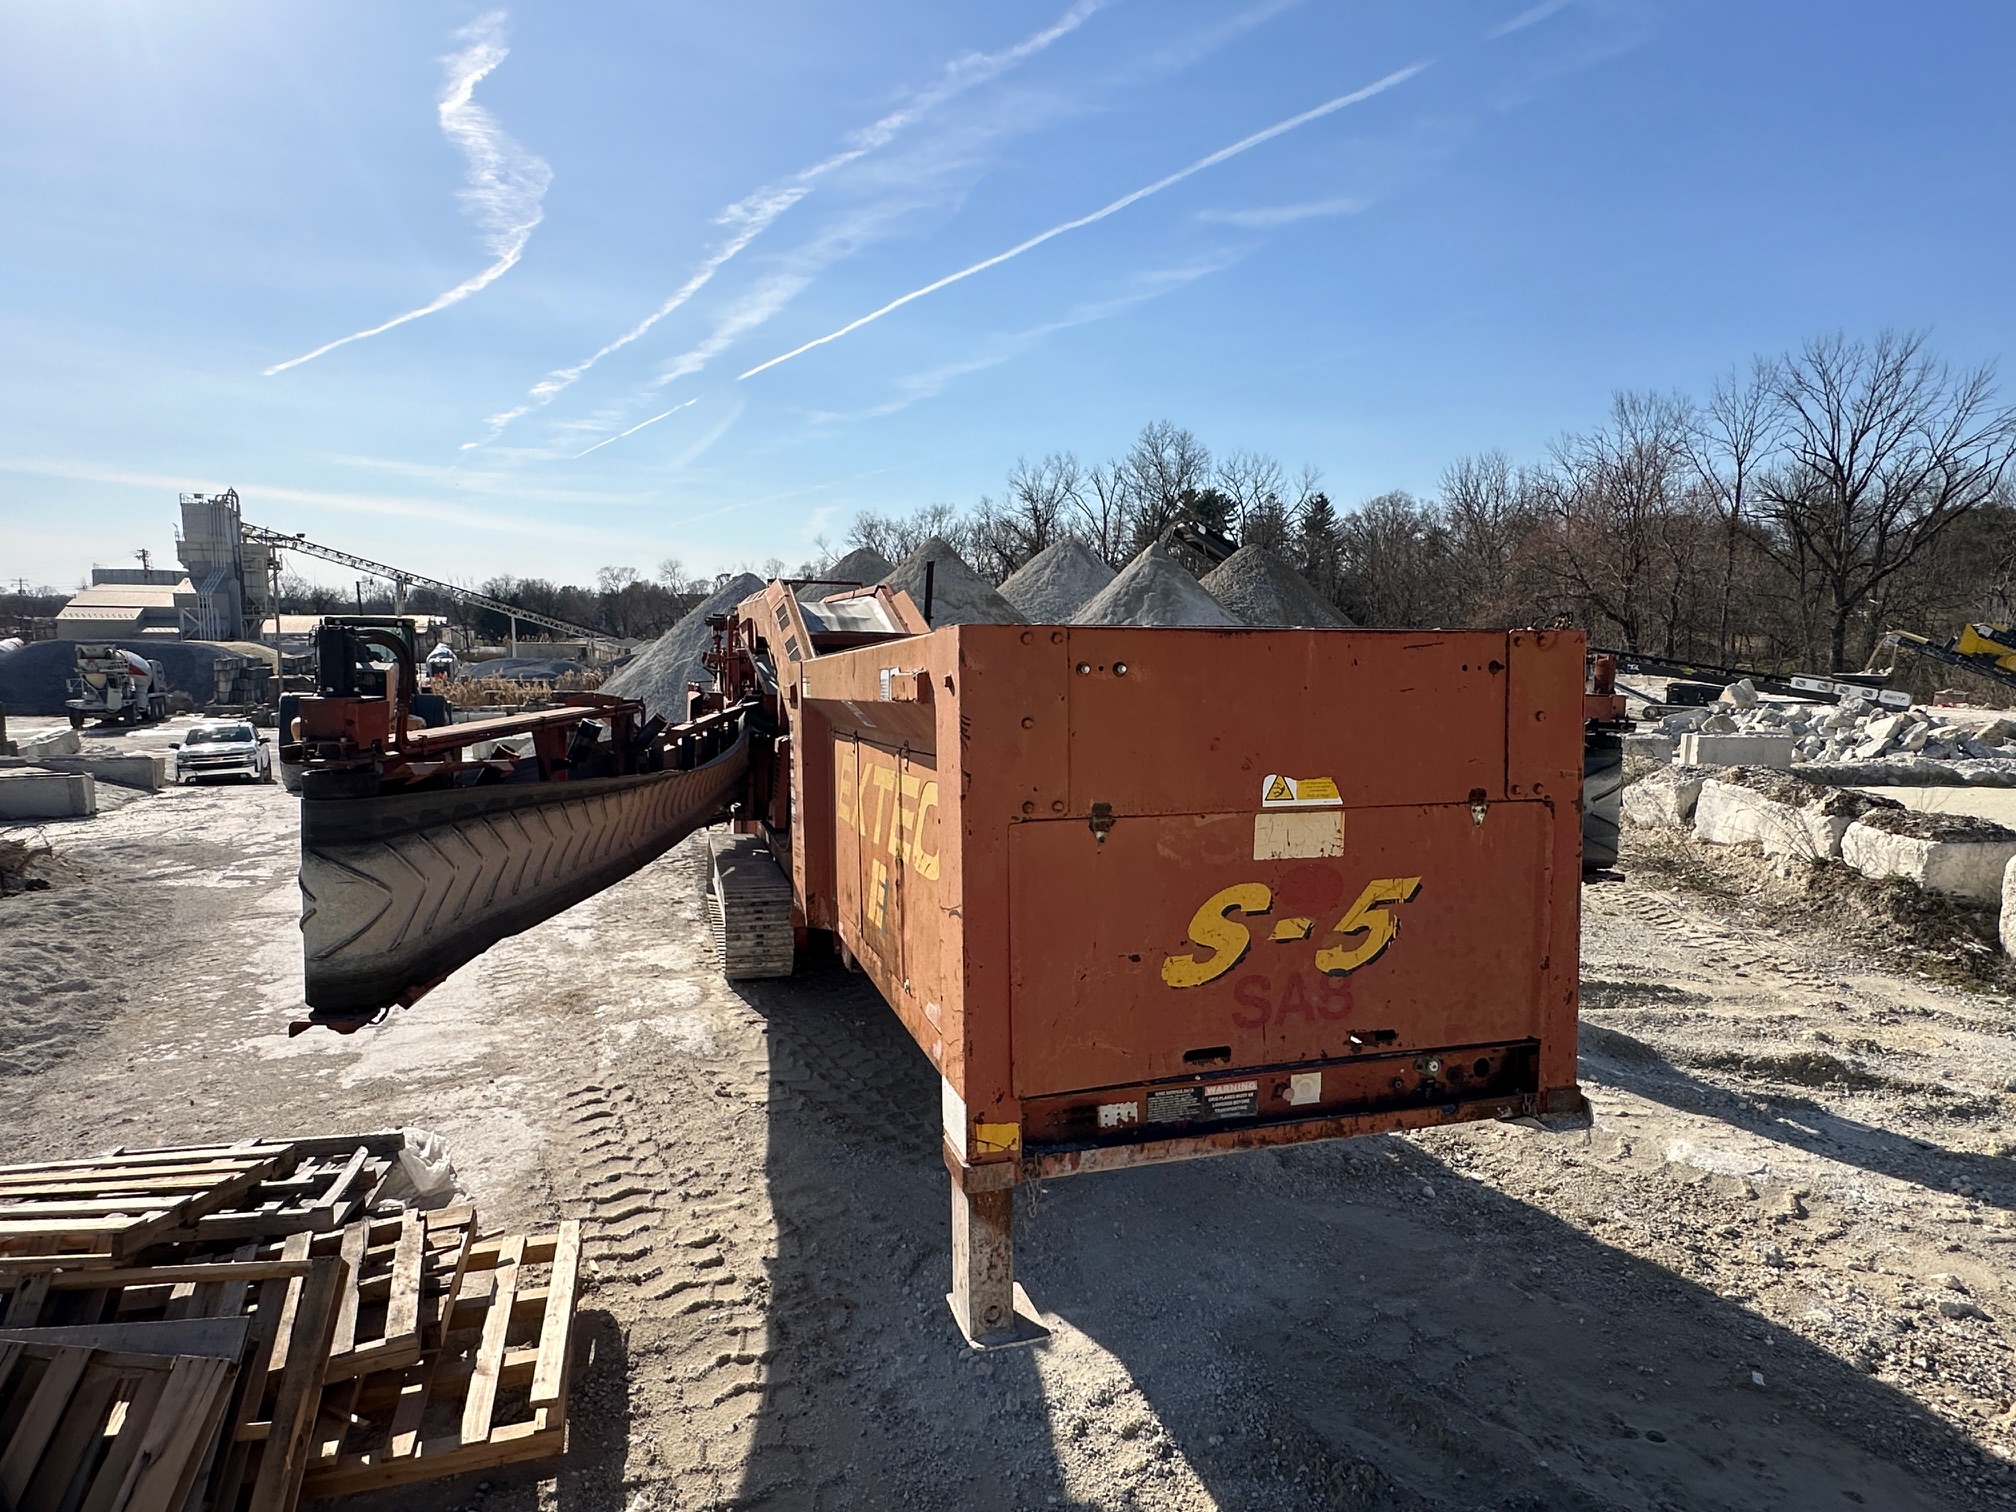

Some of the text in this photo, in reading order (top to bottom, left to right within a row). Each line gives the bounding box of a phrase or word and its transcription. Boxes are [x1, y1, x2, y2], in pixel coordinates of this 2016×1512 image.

[838, 753, 940, 881] EXTEC
[1161, 876, 1422, 988] S-5
[1232, 970, 1353, 1029] SA8
[1206, 1081, 1256, 1095] WARNING
